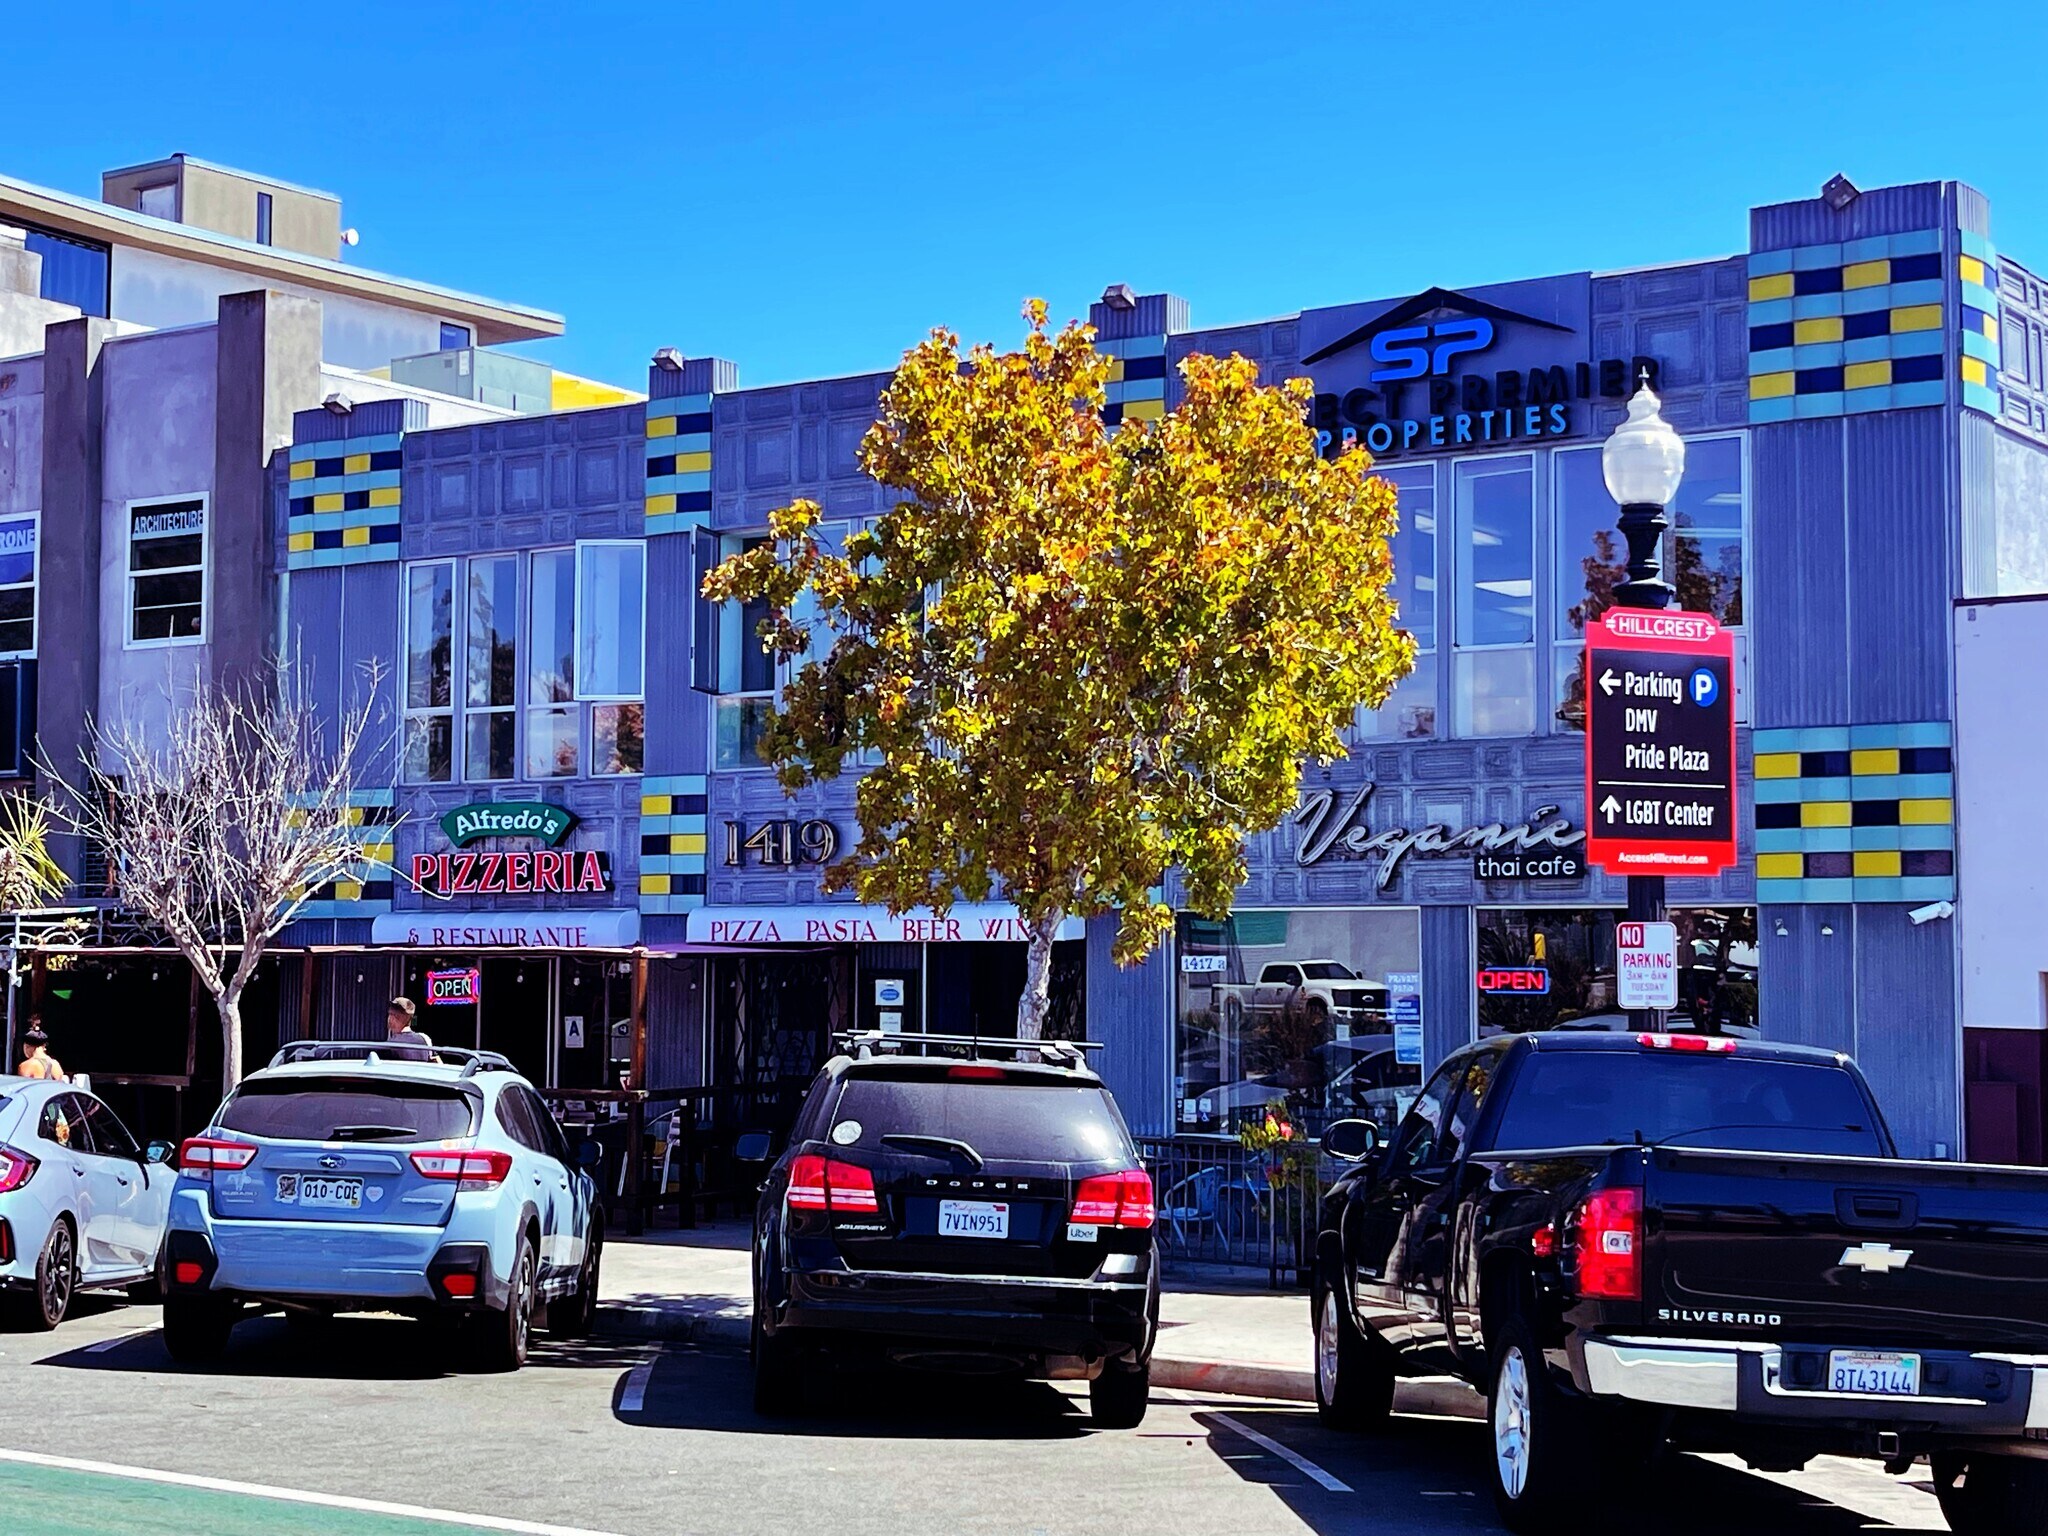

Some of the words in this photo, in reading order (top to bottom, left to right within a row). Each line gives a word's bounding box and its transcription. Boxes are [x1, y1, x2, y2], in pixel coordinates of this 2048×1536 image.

[1371, 317, 1494, 382] SP
[134, 509, 203, 535] ARCHITECTURE
[1618, 617, 1704, 638] HILLCREST
[1625, 671, 1682, 704] Parking
[1695, 674, 1713, 701] P
[1625, 708, 1658, 733] DMV
[1625, 744, 1665, 770] Pride
[1670, 745, 1709, 771] Plaza
[456, 809, 559, 837] Alfredo's
[1625, 800, 1661, 825] LGBT
[1665, 801, 1714, 826] Center
[723, 819, 840, 867] 1419
[1295, 781, 1587, 889] Veganic
[1478, 857, 1520, 877] thai
[1526, 856, 1577, 877] cafe
[1618, 852, 1708, 865] AccessHillcrest.com
[411, 850, 606, 893] PIZZERIA
[408, 928, 419, 944] &
[432, 927, 588, 947] RESTAURANTE
[710, 920, 781, 942] PIZZA
[806, 919, 878, 941] PASTA
[902, 919, 962, 941] BEER
[1622, 926, 1641, 945] NO
[1184, 957, 1213, 970] 1417
[1623, 953, 1672, 968] PARKING
[433, 978, 471, 997] OPEN
[1478, 971, 1544, 990] OPEN
[1631, 983, 1664, 991] TUESDAY
[568, 1020, 580, 1036] A
[944, 1213, 1003, 1233] 7VIN951
[1070, 1228, 1094, 1238] Uber
[1658, 1309, 1781, 1325] SILVERADO
[1834, 1368, 1912, 1393] 8T43144
